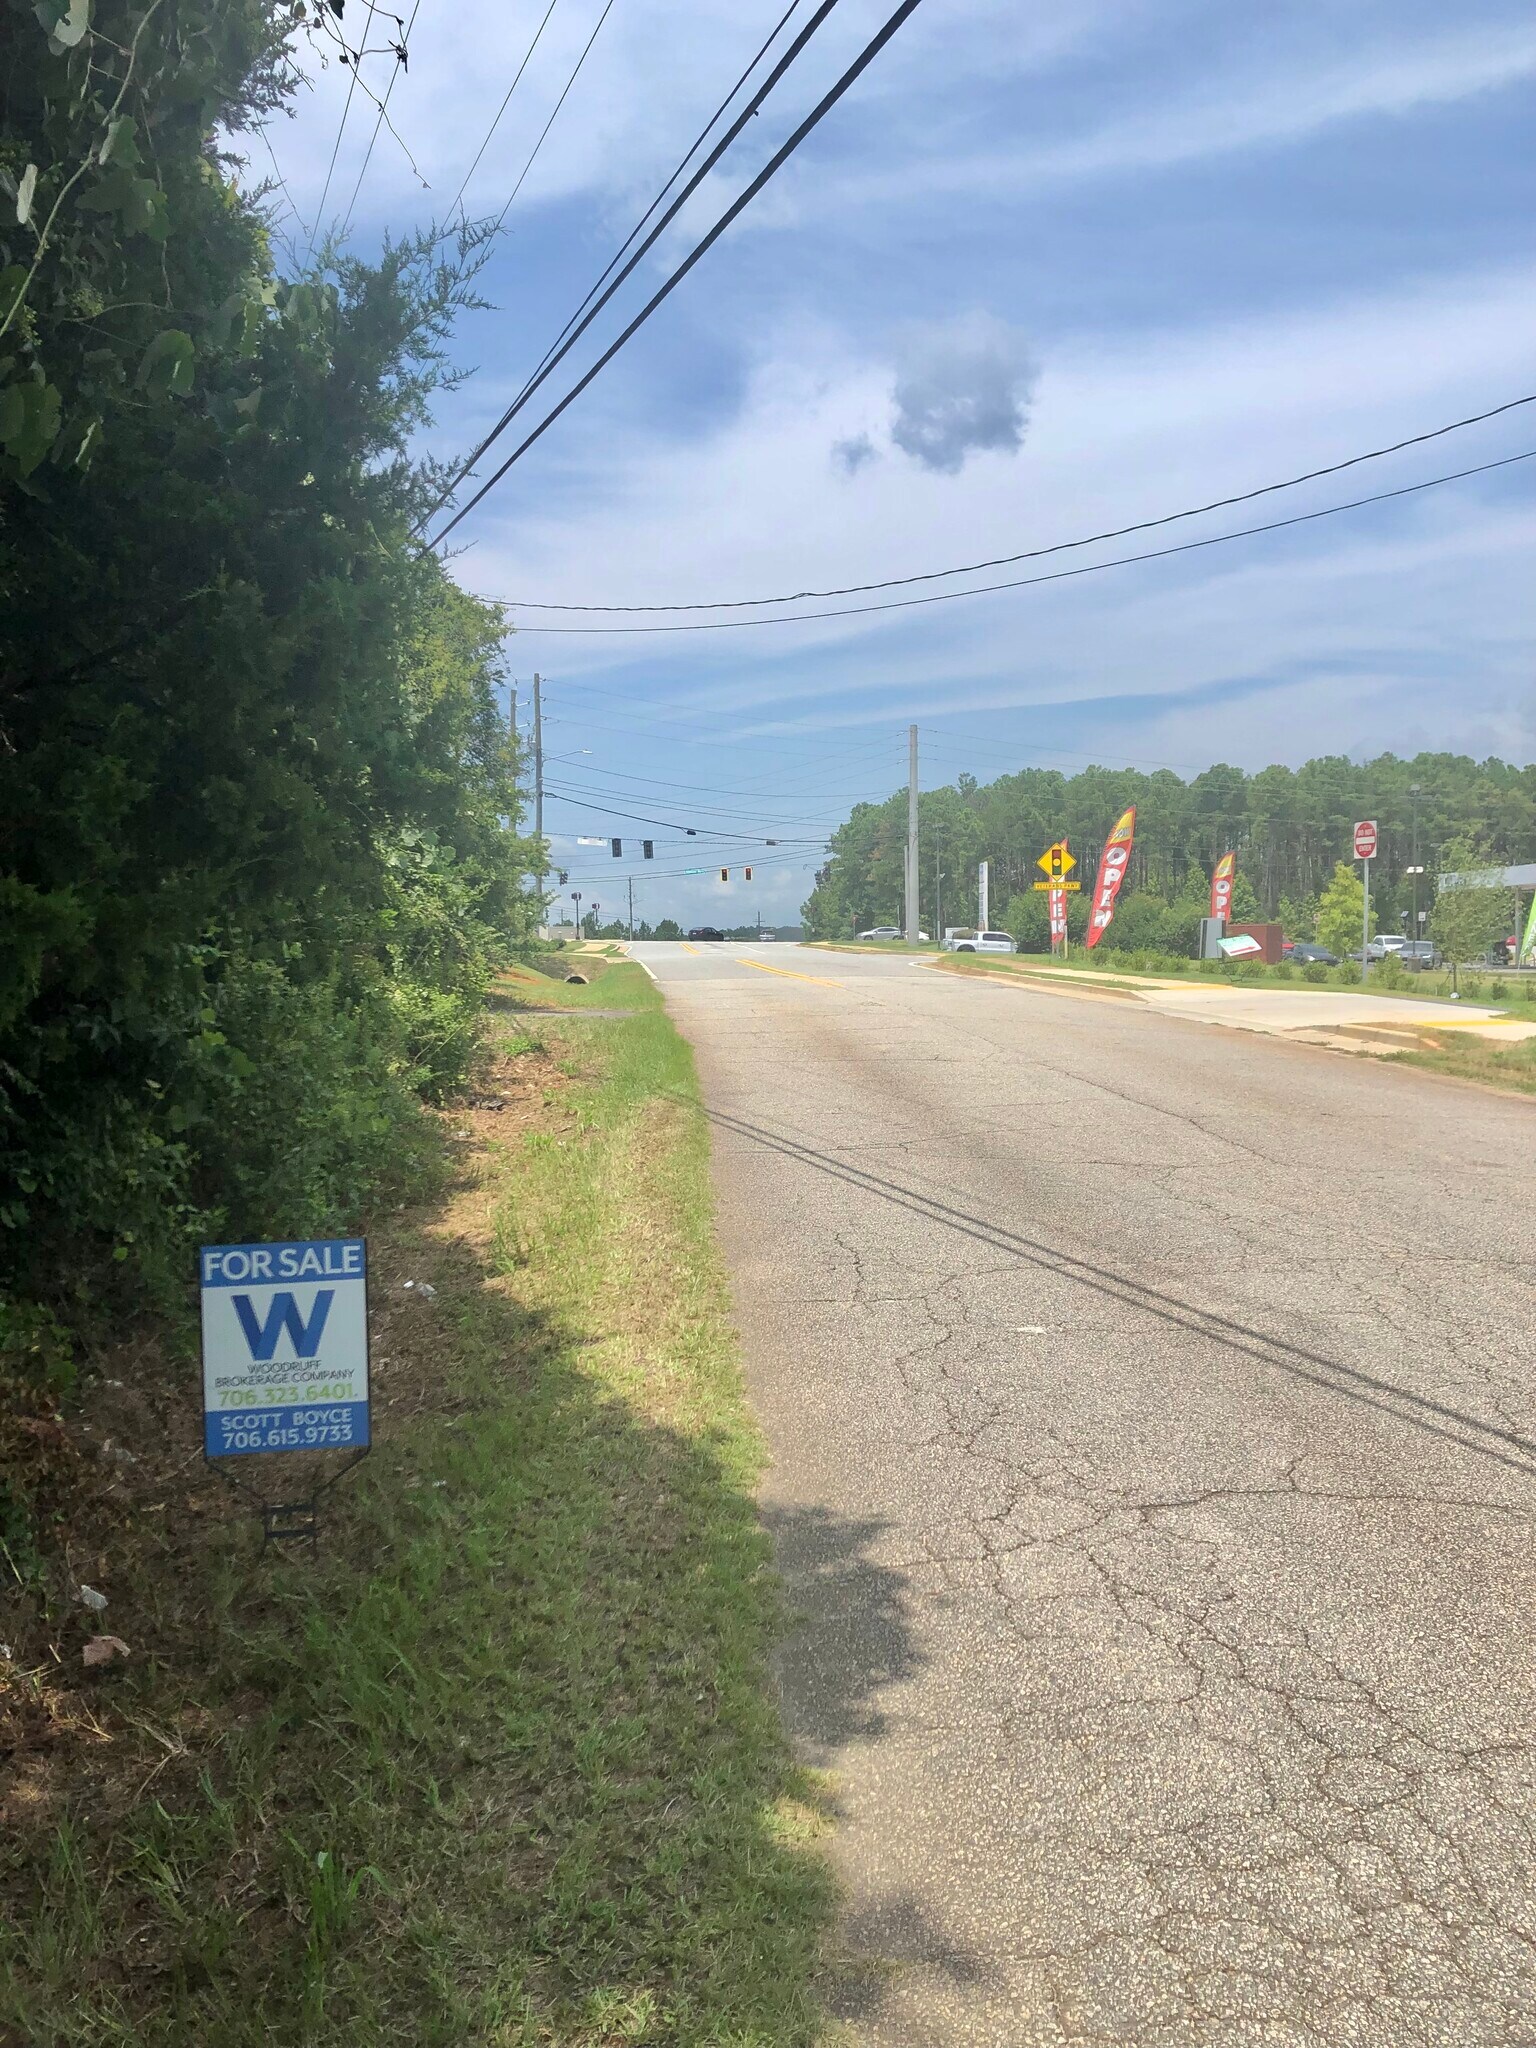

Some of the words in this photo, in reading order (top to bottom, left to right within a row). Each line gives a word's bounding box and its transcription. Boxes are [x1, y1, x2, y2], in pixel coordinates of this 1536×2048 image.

[1364, 828, 1373, 836] NOT
[1358, 844, 1372, 852] ENTER
[1094, 847, 1126, 927] OPEN
[204, 1251, 274, 1280] FOR
[279, 1245, 361, 1277] SALE
[231, 1289, 336, 1361] W
[215, 1373, 292, 1388] BROKERAGE
[292, 1368, 356, 1383] COMPANY
[247, 1359, 322, 1374] WOODRUFF
[219, 1383, 353, 1406] 706.323.6401
[221, 1412, 284, 1431] SCOTT
[292, 1408, 353, 1426] BOYCE
[223, 1425, 353, 1449] 706.615.9733
